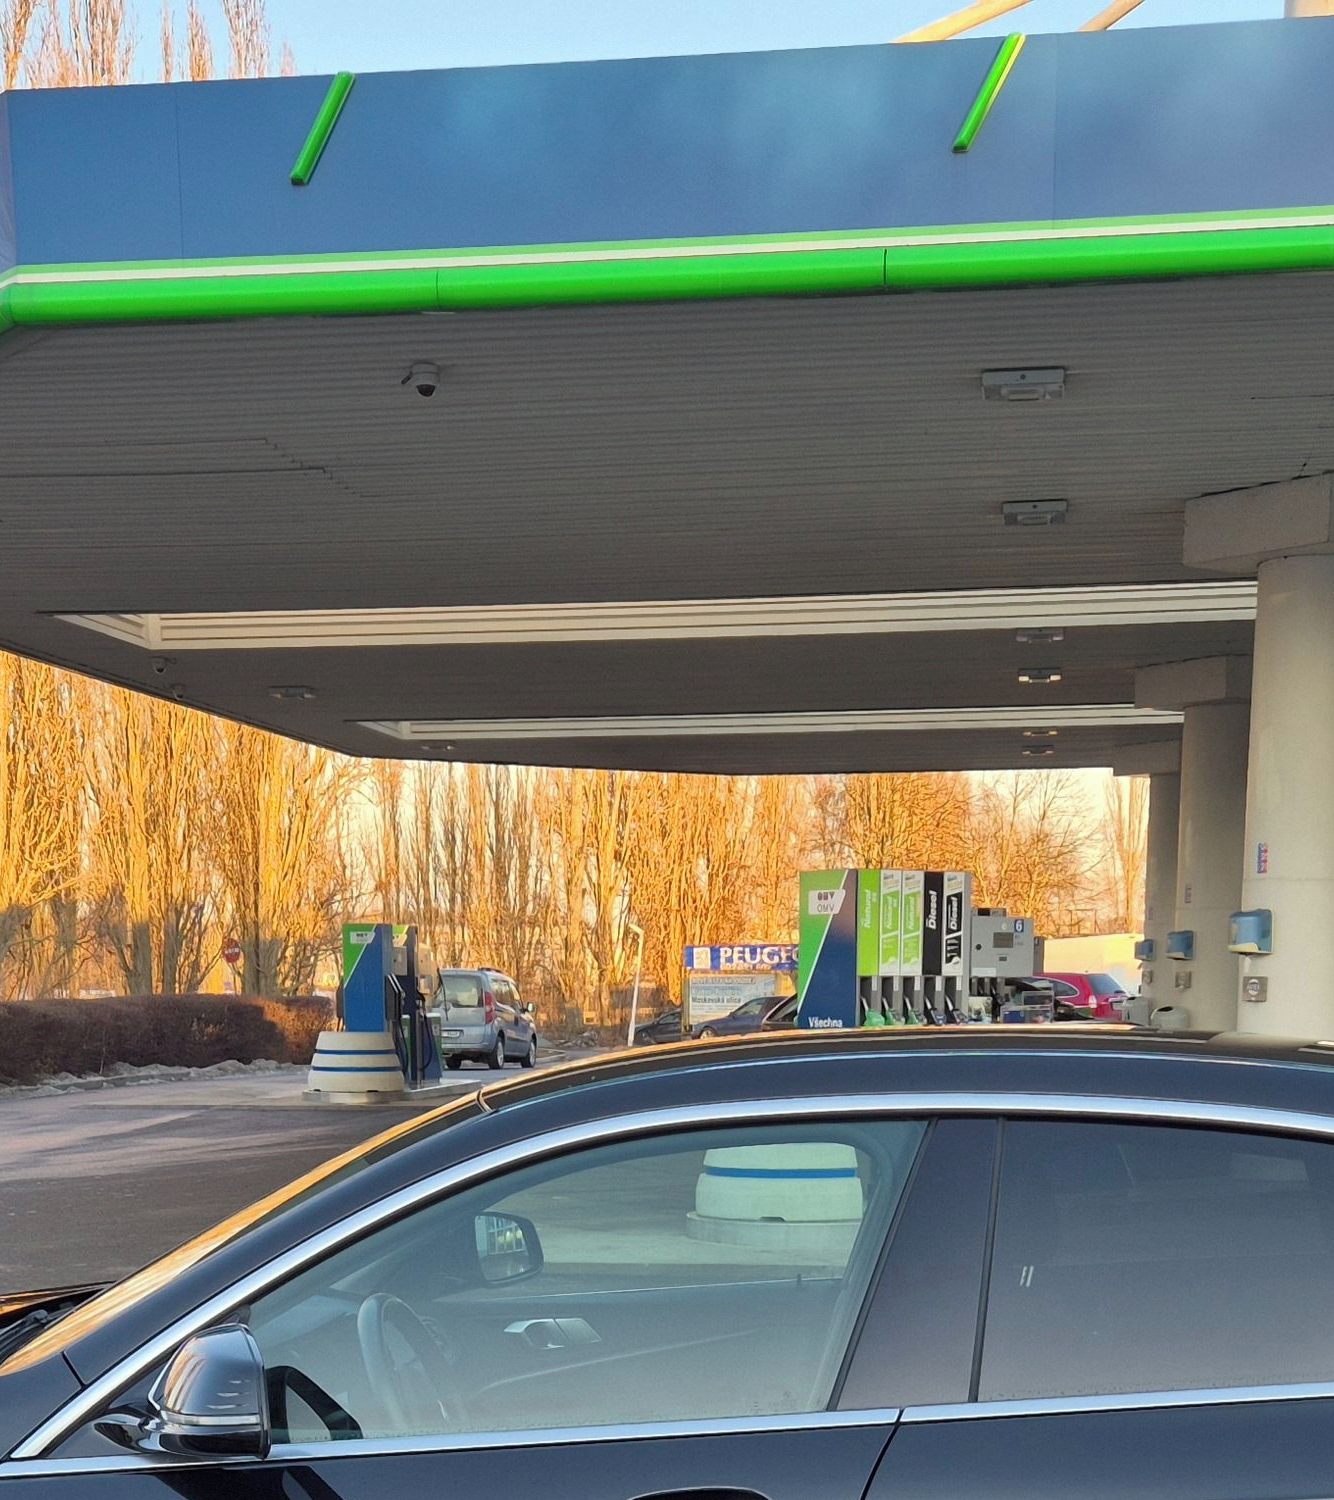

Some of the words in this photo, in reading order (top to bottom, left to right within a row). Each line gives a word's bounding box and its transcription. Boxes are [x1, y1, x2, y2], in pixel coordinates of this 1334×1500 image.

[928, 889, 938, 930] Diesel
[950, 896, 959, 930] Diesel
[1015, 920, 1023, 932] 6
